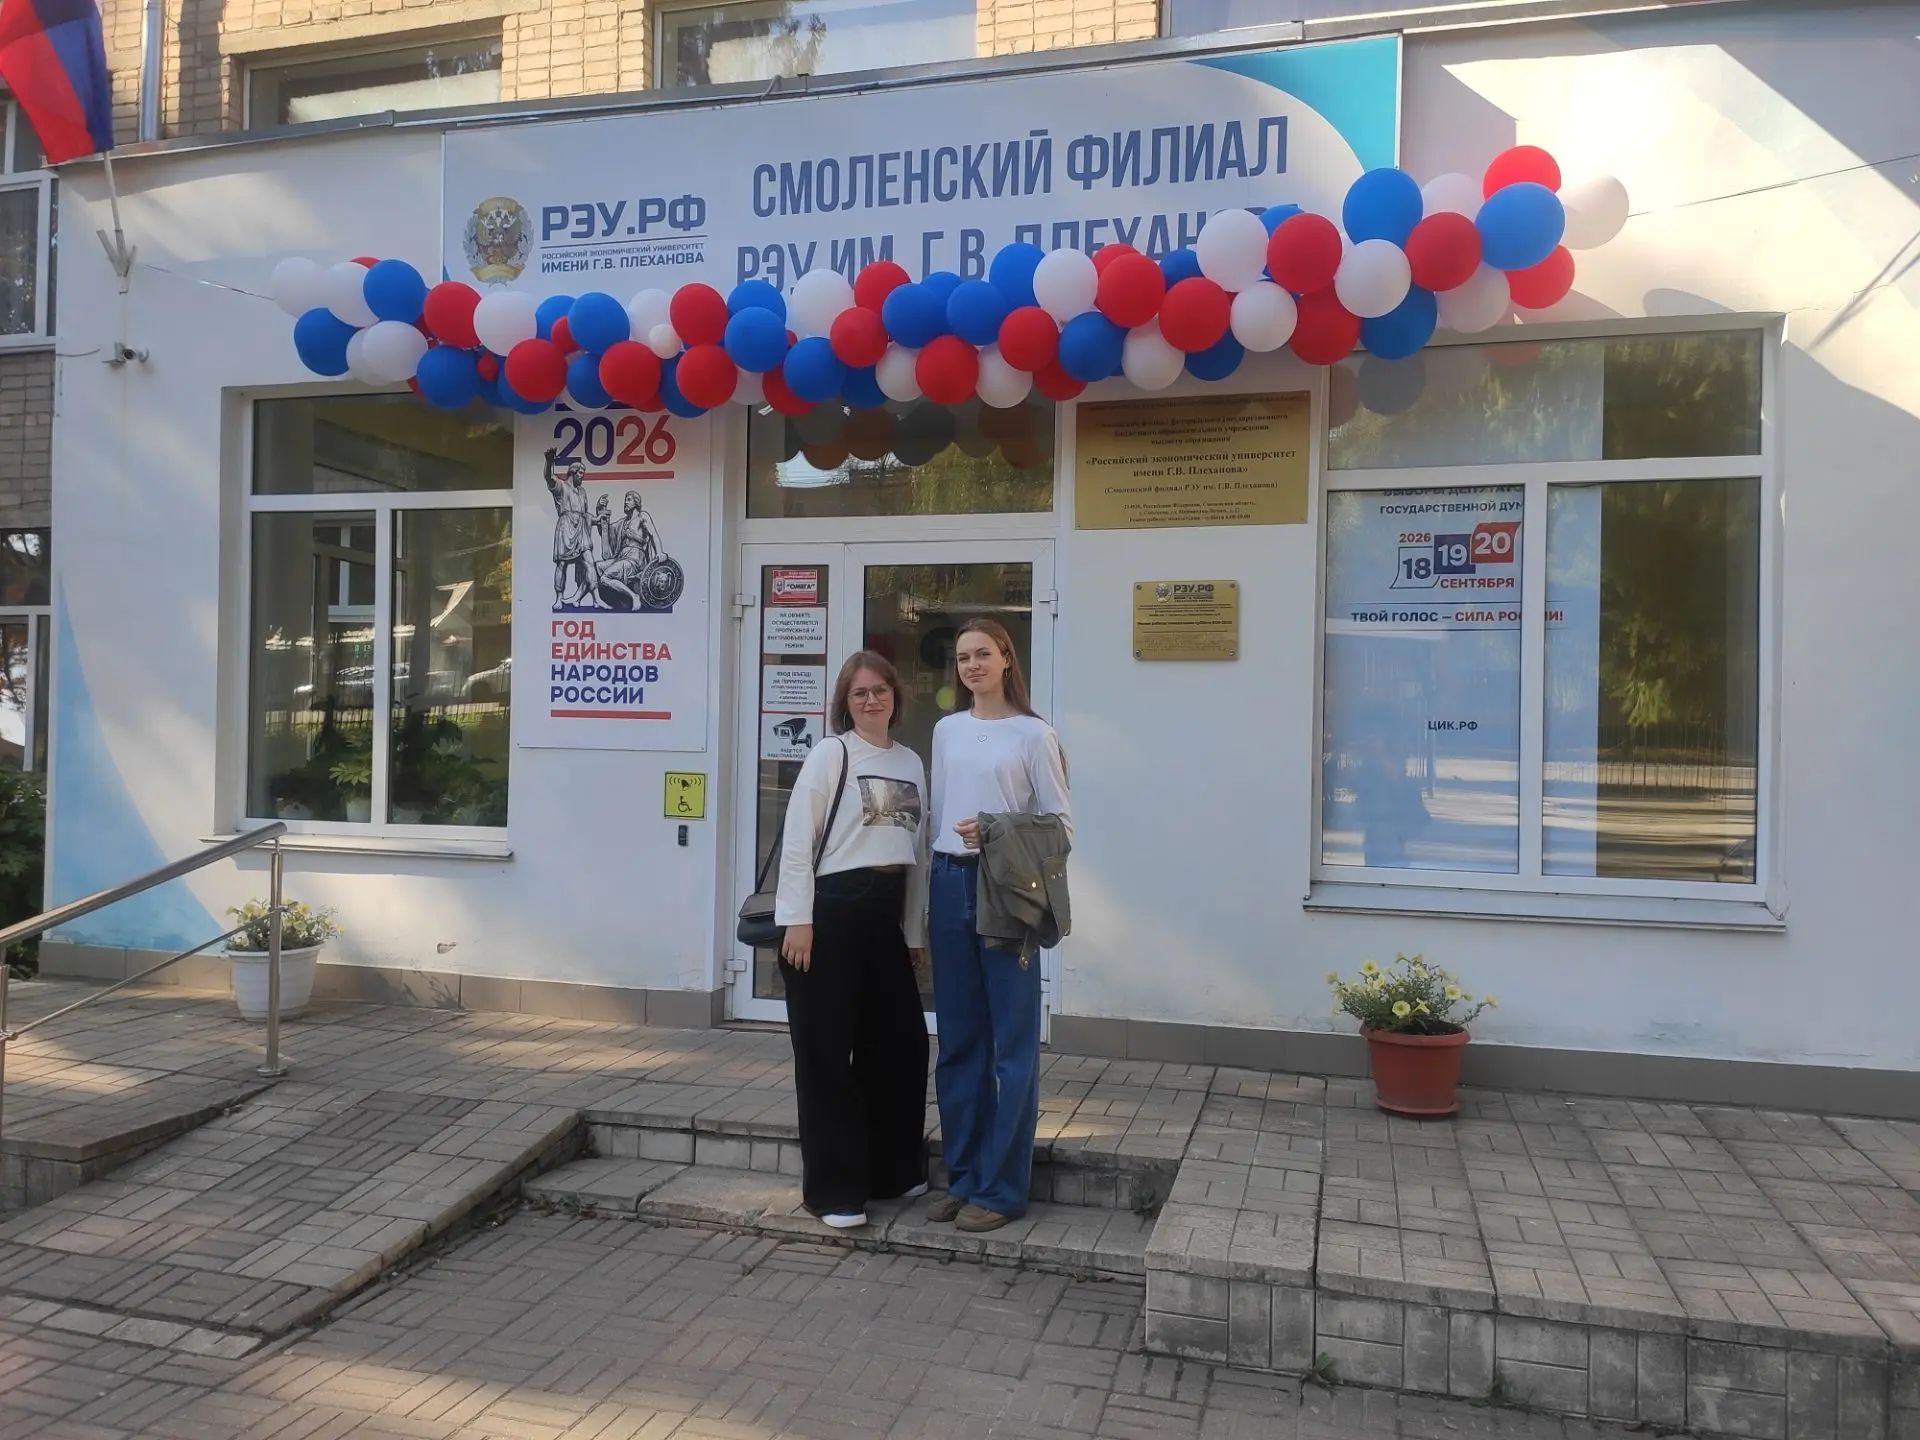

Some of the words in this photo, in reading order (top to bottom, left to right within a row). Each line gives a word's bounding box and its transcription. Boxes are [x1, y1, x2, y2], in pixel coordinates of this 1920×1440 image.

[754, 129, 1051, 217] СМОЛЕНСКИЙ
[1067, 116, 1288, 190] ФИЛИАЛ
[541, 194, 706, 241] РЭУ.РФ
[542, 250, 588, 259] РОССИЙСКИЙ
[590, 246, 651, 257] ЭКОНОМИЧЕСКИЙ
[653, 242, 704, 252] УНИВЕРСИТЕТ
[541, 260, 589, 273] ИМЕНИ
[593, 258, 616, 270] Г.В.
[620, 252, 705, 268] ПЛЕХАНОВА
[737, 241, 817, 295] РЭУ
[554, 415, 676, 466] 2026
[1086, 455, 1148, 466] «Российский
[1151, 453, 1229, 464] экономический
[1231, 450, 1296, 462] университет
[1133, 469, 1164, 477] имени
[1167, 467, 1185, 476] Г.В.
[1188, 466, 1248, 475] Плеханова»
[1380, 500, 1496, 514] ГОСУДАРСТВЕННОЙ
[1400, 533, 1431, 543] 2026
[1403, 558, 1431, 579] 18
[1438, 545, 1467, 566] 19
[1474, 532, 1511, 554] 20
[1173, 584, 1214, 593] РЭУ.РФ
[1440, 578, 1515, 588] СЕНТЯБРЯ
[1352, 611, 1388, 622] ТВОЙ
[1392, 612, 1438, 622] ГОЛОС
[1455, 612, 1494, 622] СИЛА
[552, 621, 595, 640] ГОД
[552, 643, 672, 662] ЕДИНСТВА
[552, 664, 659, 684] НАРОДОВ
[551, 686, 644, 704] РОССИИ
[1428, 721, 1478, 731] ЦИК.РФ
